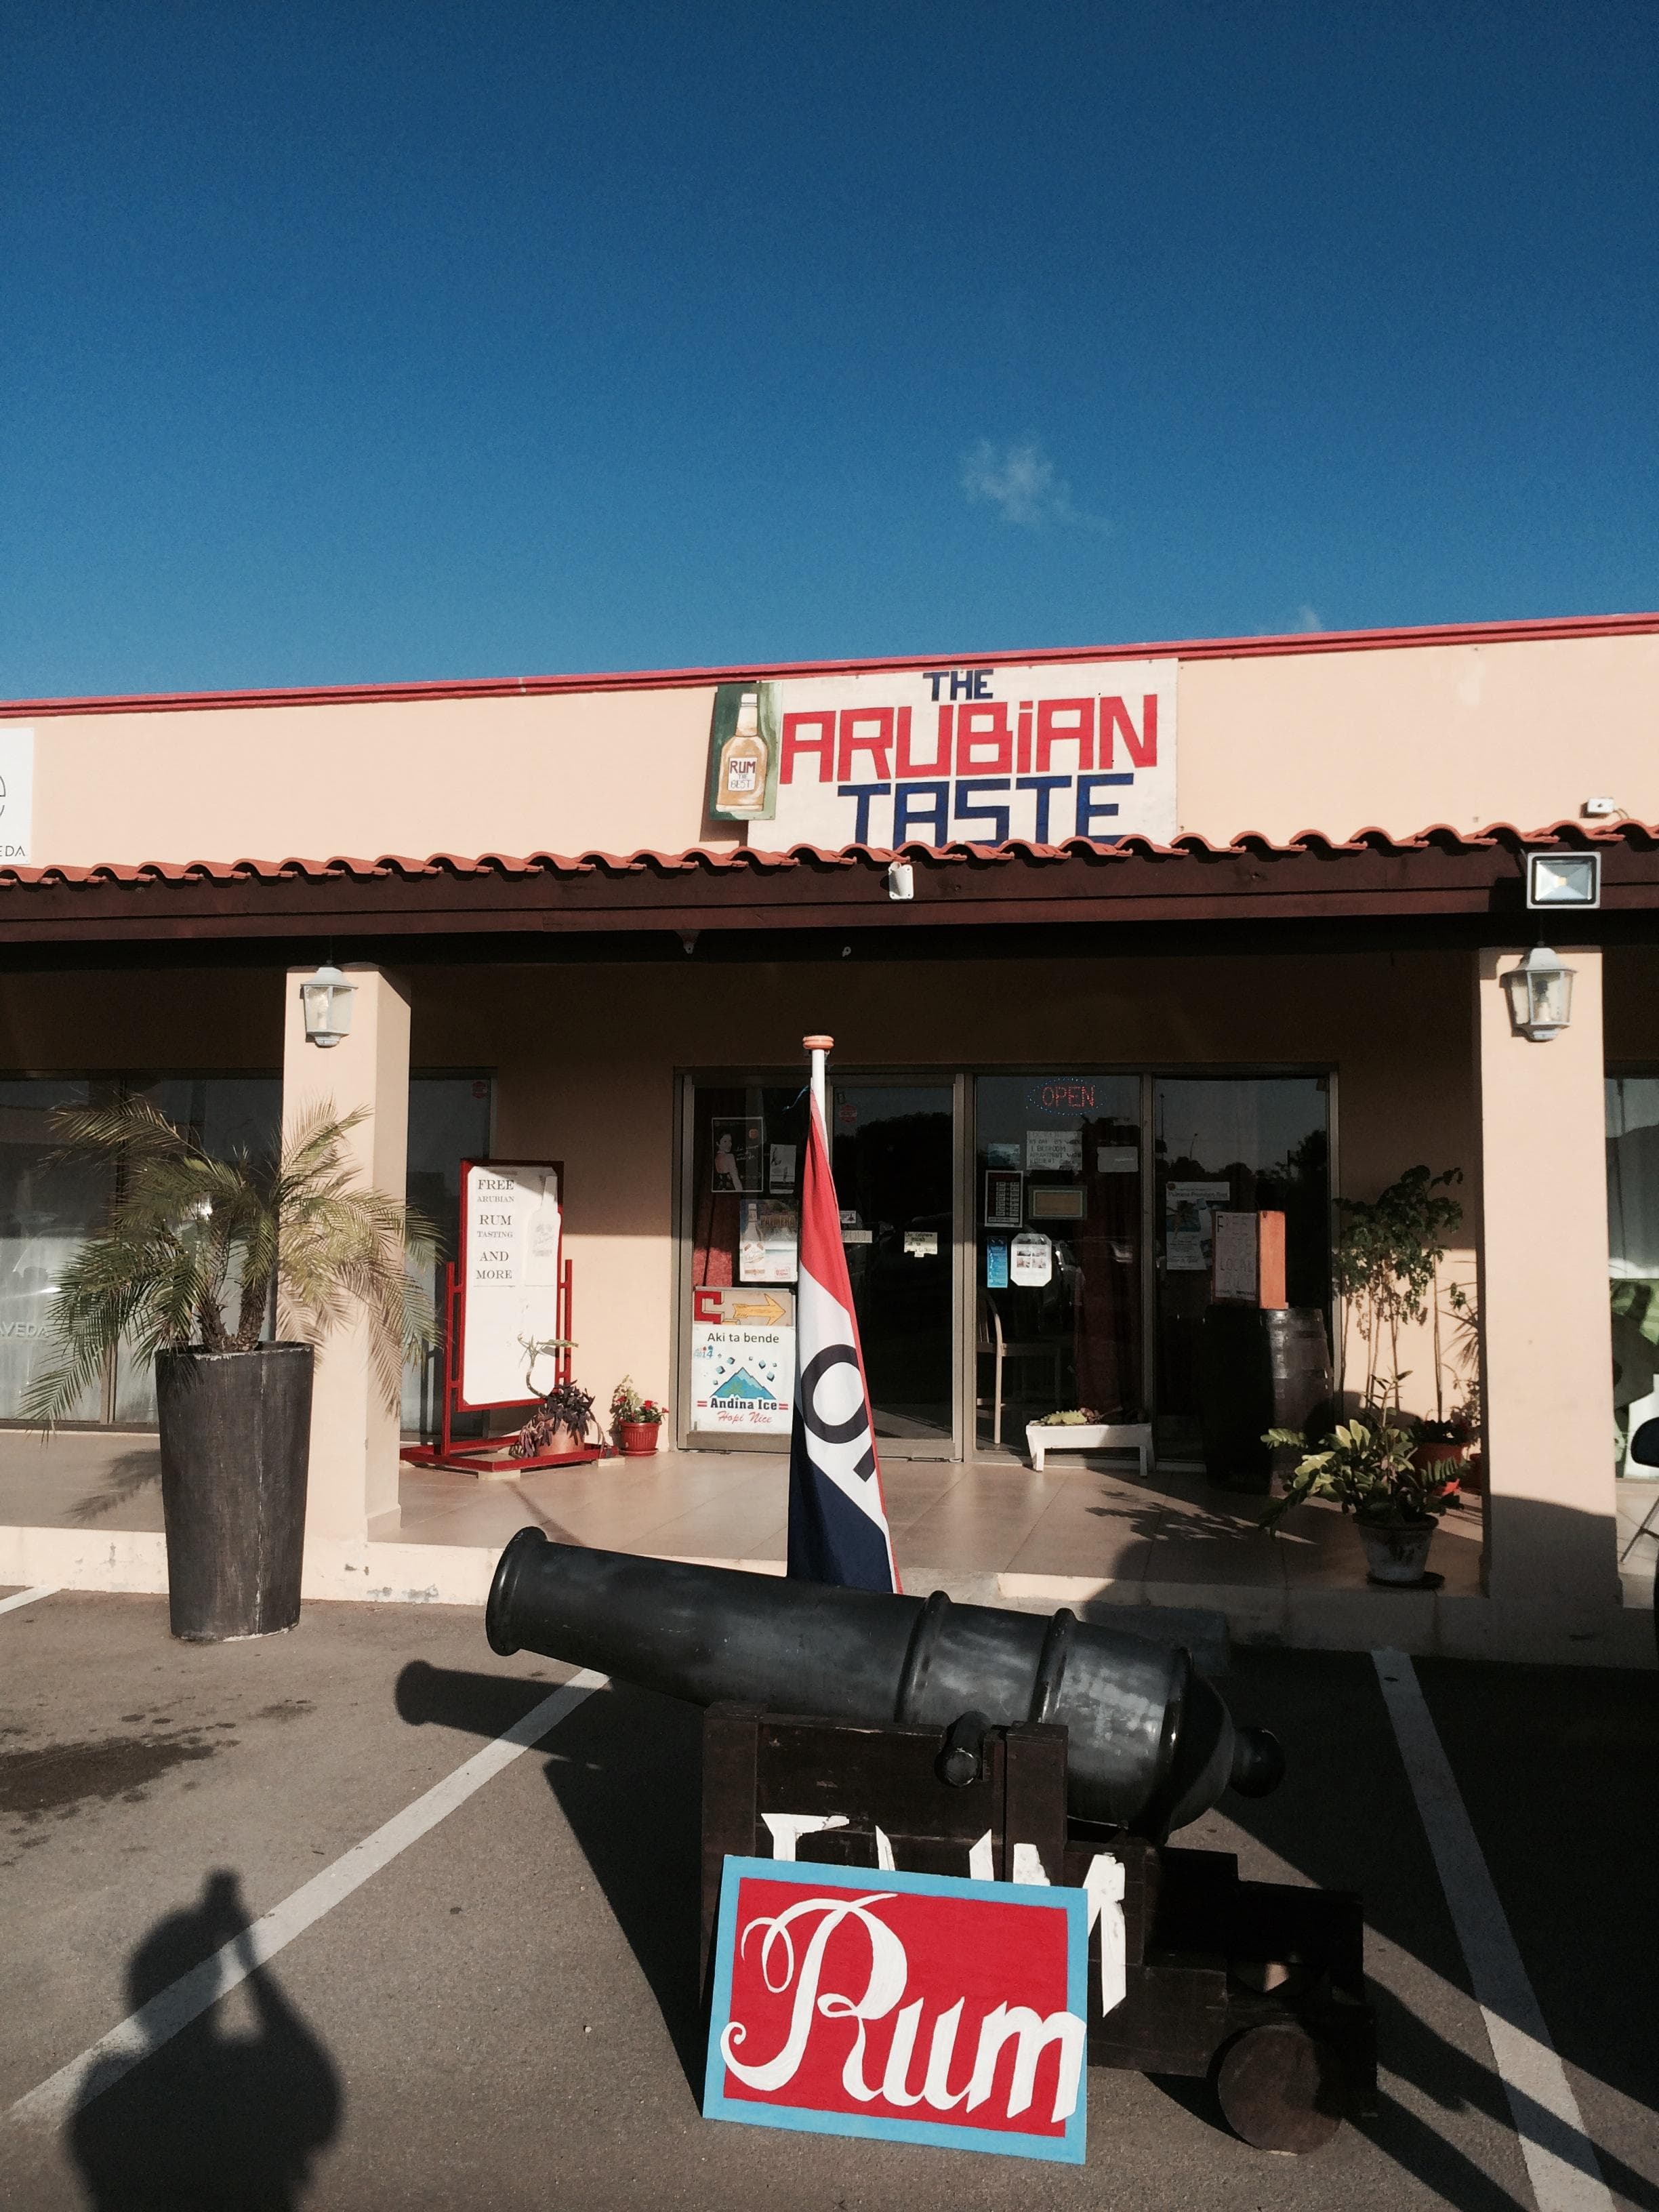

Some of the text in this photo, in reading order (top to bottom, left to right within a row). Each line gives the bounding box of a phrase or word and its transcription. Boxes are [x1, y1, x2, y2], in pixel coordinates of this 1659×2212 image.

[922, 669, 994, 702] THE
[730, 760, 756, 774] RUM
[731, 779, 752, 789] BEST
[837, 773, 1134, 850] TASTE
[1041, 1086, 1096, 1107] OPEN
[478, 1179, 514, 1190] FREE
[479, 1214, 512, 1225] RUM
[479, 1251, 509, 1262] AND
[476, 1270, 512, 1279] MORE
[707, 1332, 779, 1343] Aki ta bende
[710, 1397, 777, 1410] Andina Ice
[749, 1411, 773, 1424] Nice
[720, 1893, 1087, 2123] Rum
